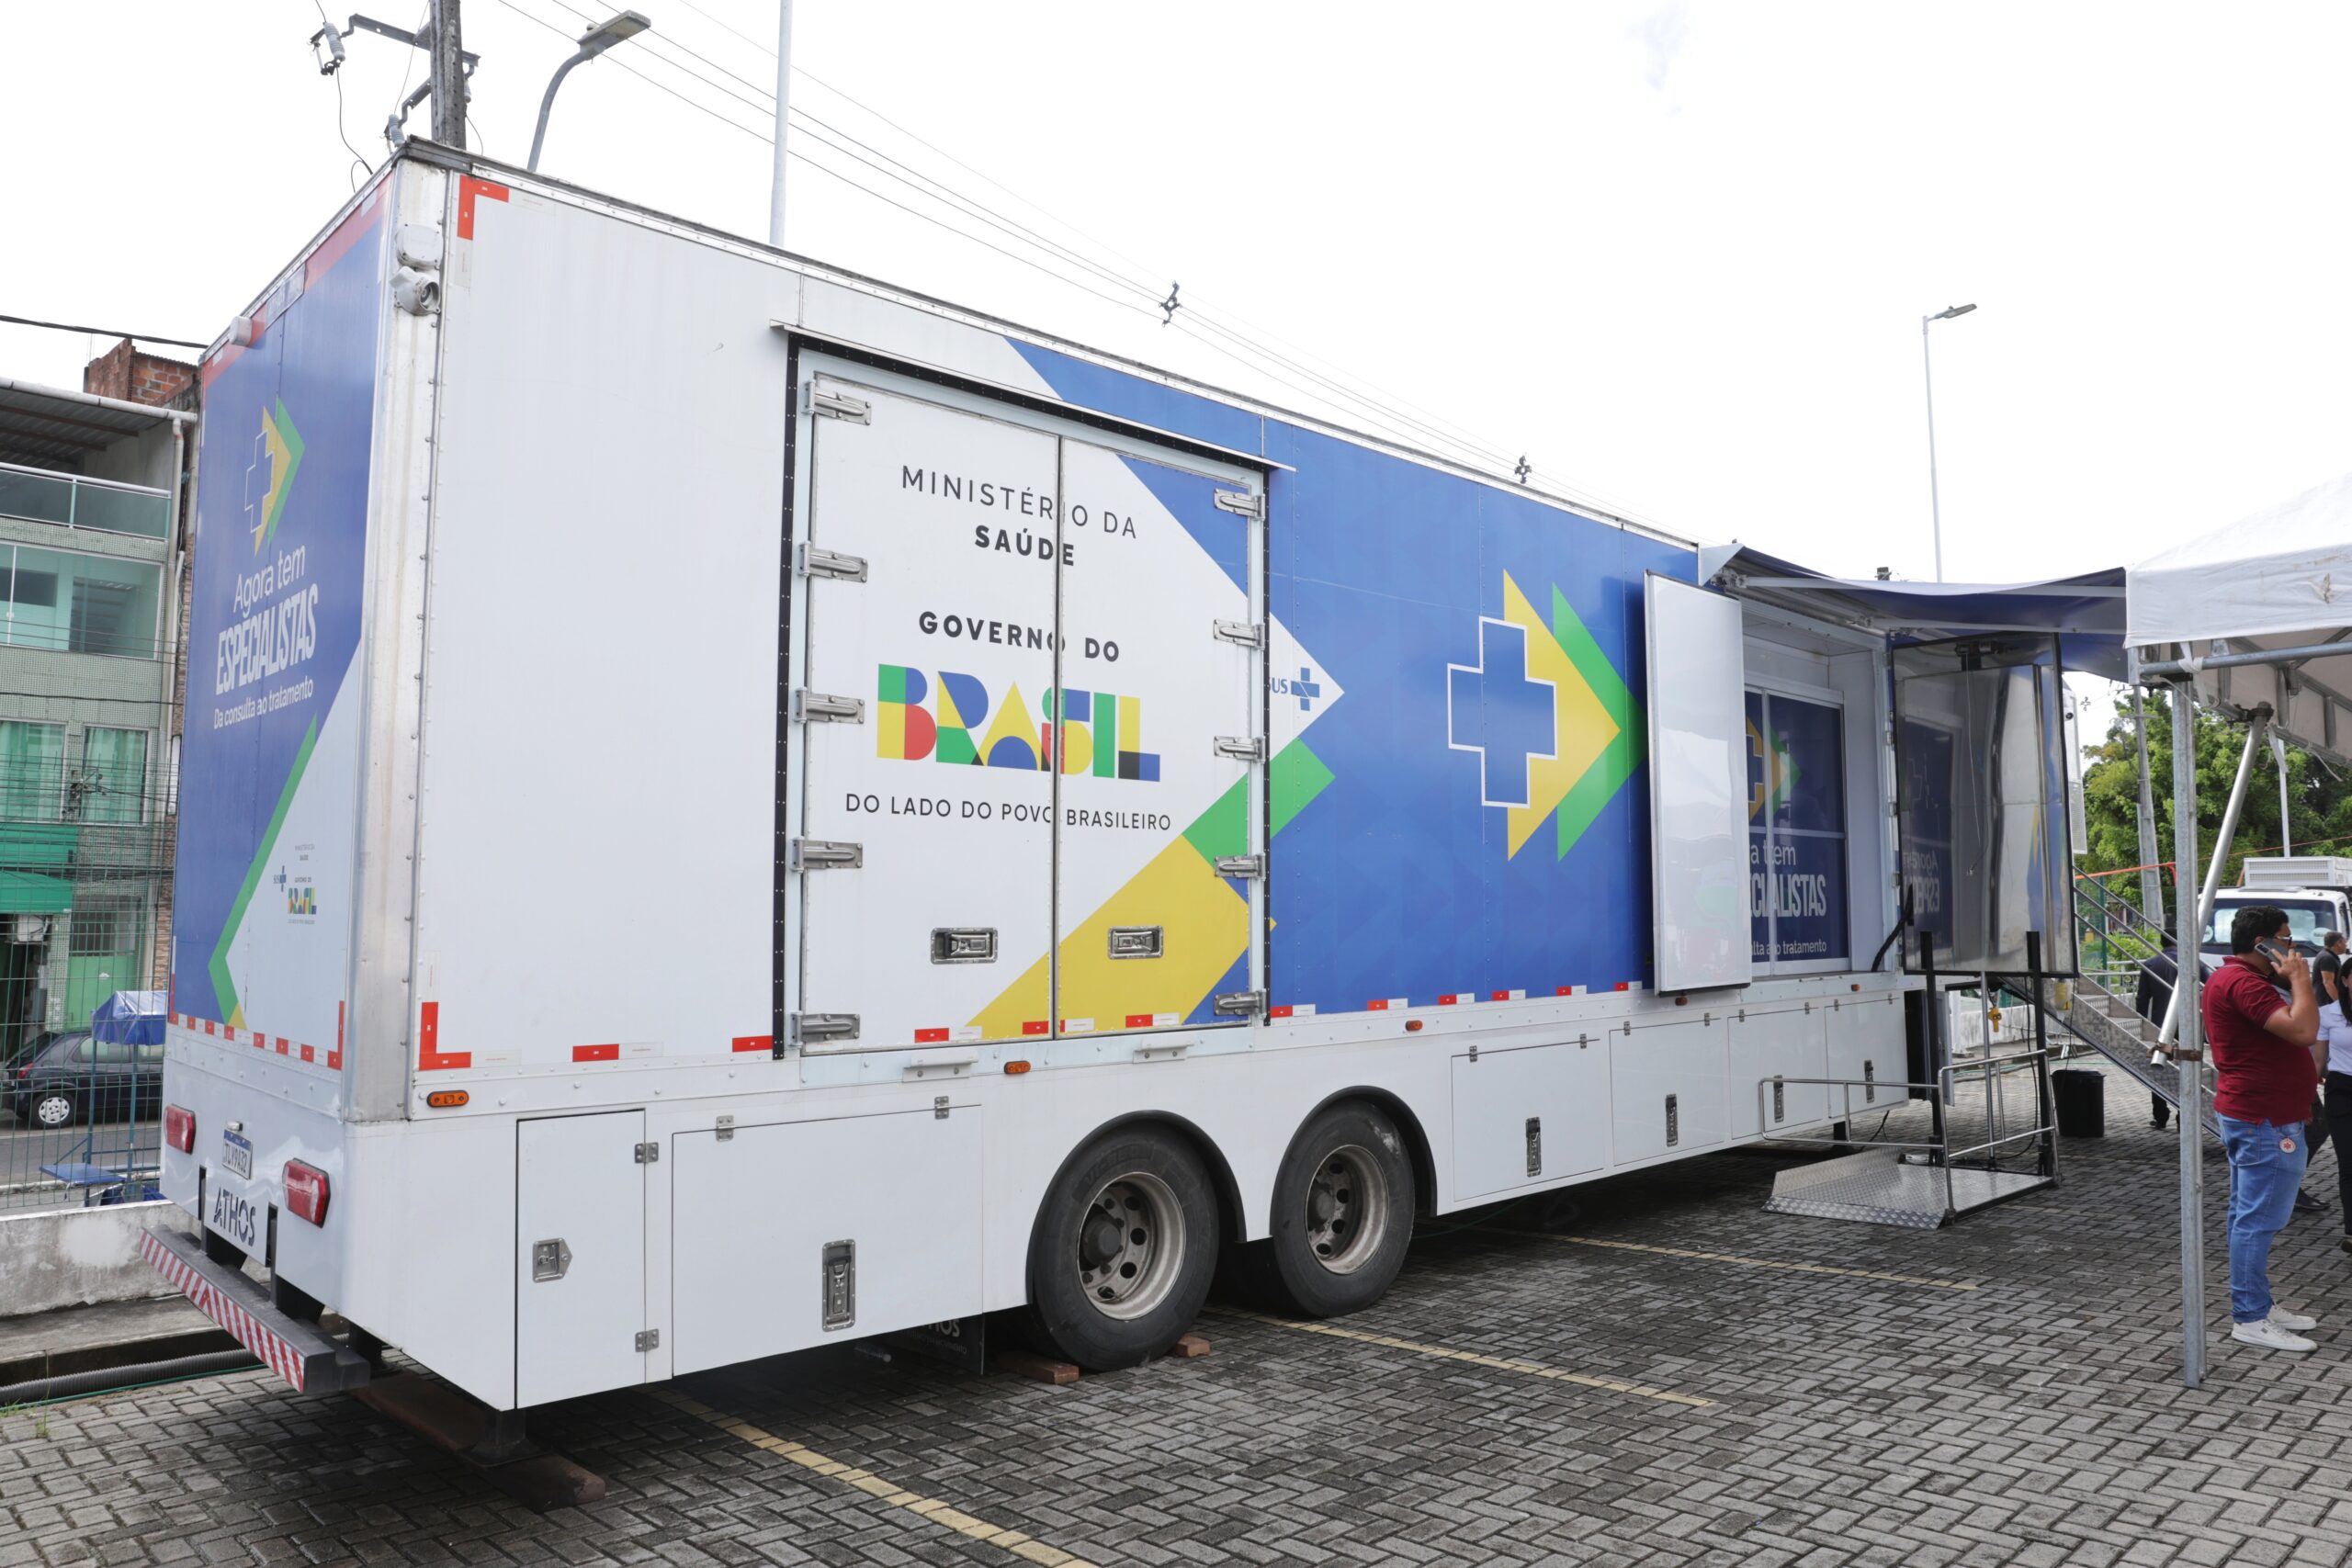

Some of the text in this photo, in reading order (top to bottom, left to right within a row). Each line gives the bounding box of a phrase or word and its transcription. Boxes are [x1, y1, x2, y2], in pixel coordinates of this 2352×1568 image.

[975, 525, 1074, 566] SAÚDE
[1103, 511, 1136, 539] DA
[233, 545, 306, 618] Agora tem
[216, 583, 318, 695] ESPECIALISTAS
[919, 611, 1119, 662] GOVERNO DO
[214, 675, 313, 729] Da consulta ao tratamento
[876, 663, 1160, 782] BRASIL
[846, 793, 879, 813] DO
[890, 796, 951, 818] LADO
[962, 800, 991, 819] DO
[1067, 808, 1171, 830] BRASILEIRO
[1782, 938, 1827, 955] tratamento
[213, 1186, 256, 1247] ATHOS
